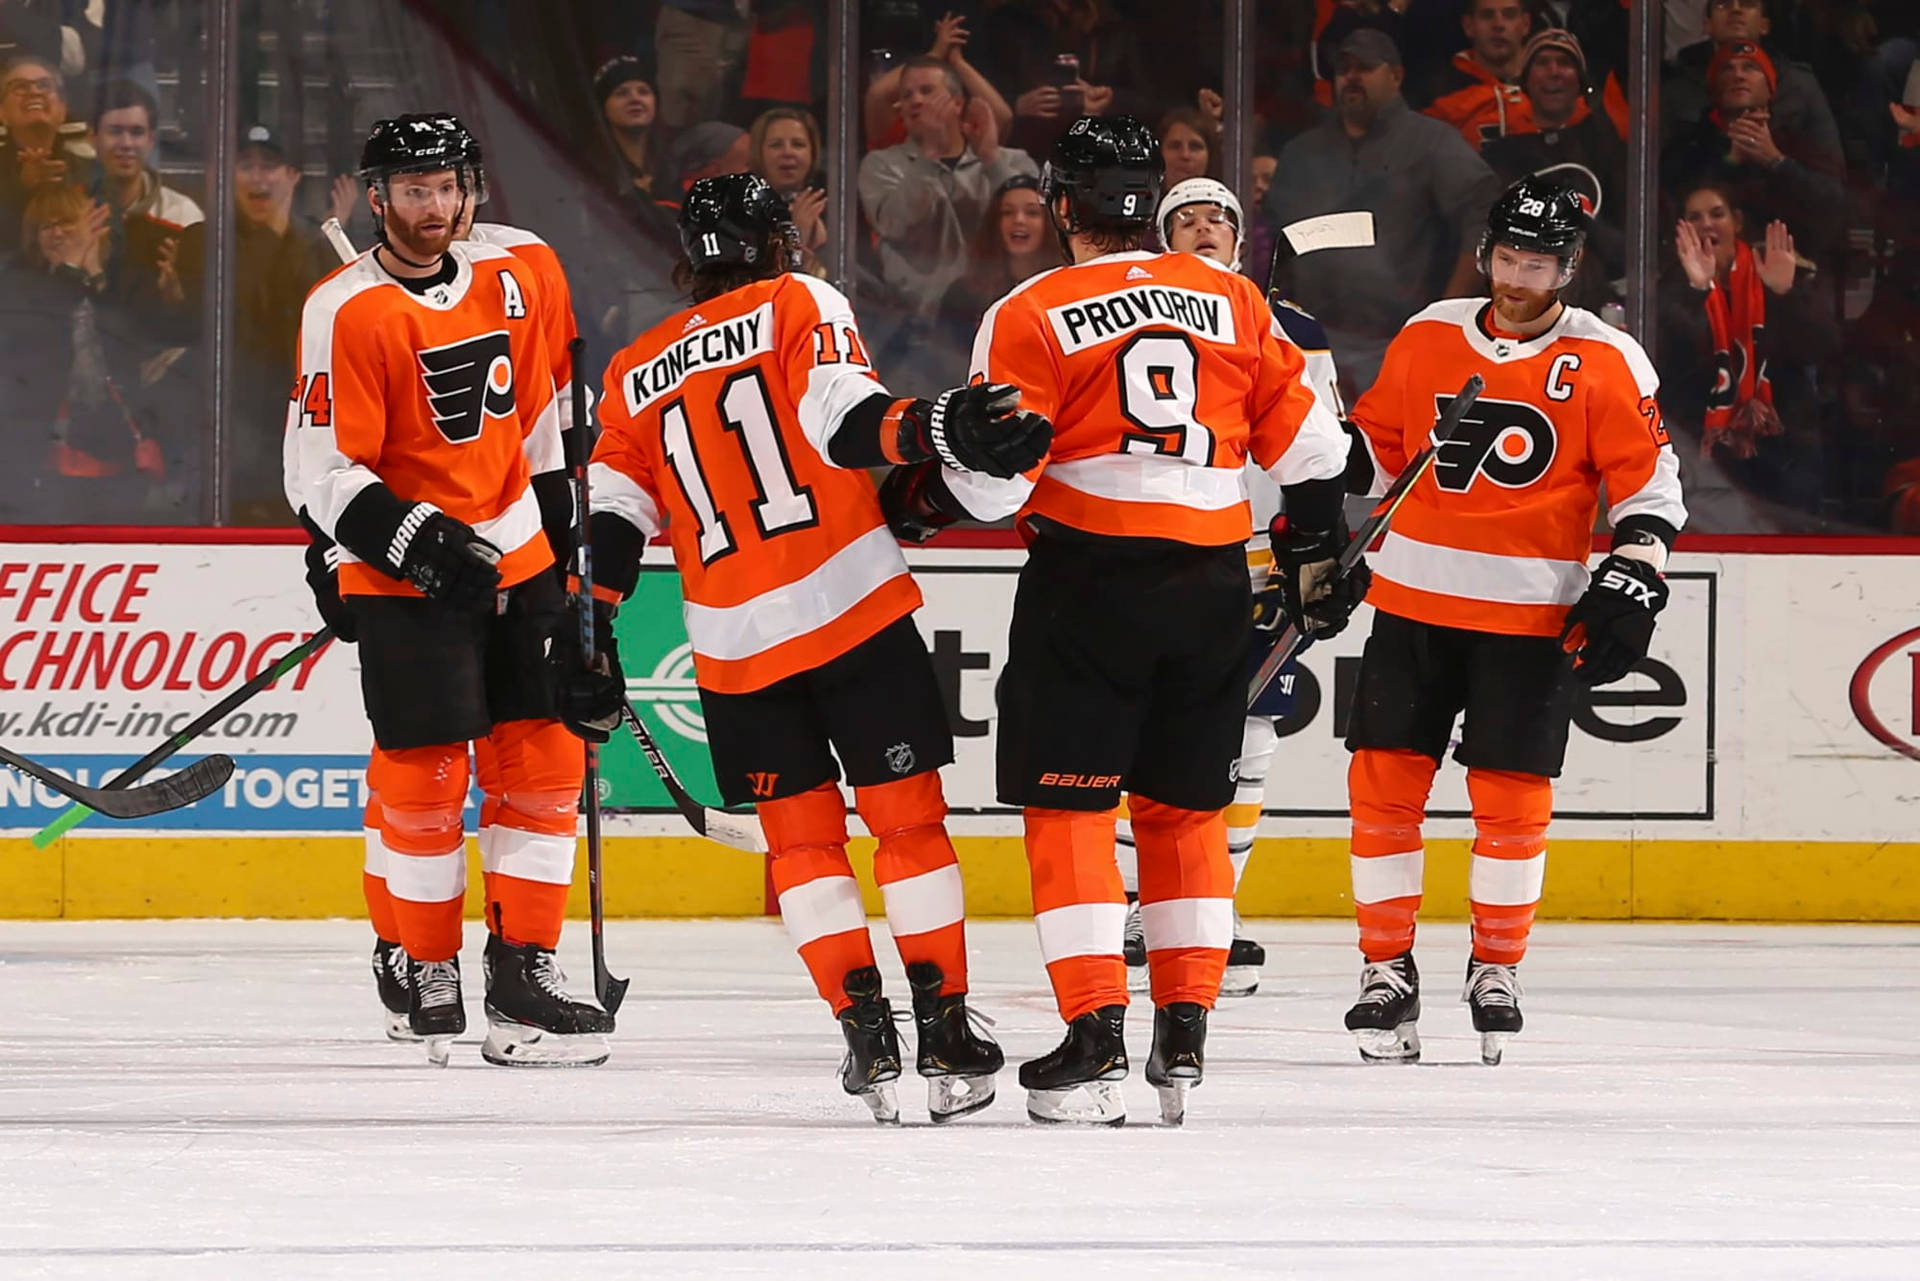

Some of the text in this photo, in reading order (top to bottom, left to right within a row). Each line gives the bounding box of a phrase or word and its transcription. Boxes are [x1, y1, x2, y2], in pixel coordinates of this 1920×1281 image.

[1122, 194, 1137, 216] 9
[1519, 197, 1545, 217] 28
[702, 232, 720, 256] 11
[496, 269, 526, 319] A
[1061, 289, 1219, 345] PROVOROV
[632, 311, 761, 405] KONECNY
[813, 322, 869, 367] 11
[1116, 331, 1216, 468] 9
[1545, 353, 1582, 402] C
[1637, 395, 1671, 447] 2
[660, 366, 819, 566] 11
[0, 563, 159, 622] FFICE
[1599, 569, 1660, 609] STX
